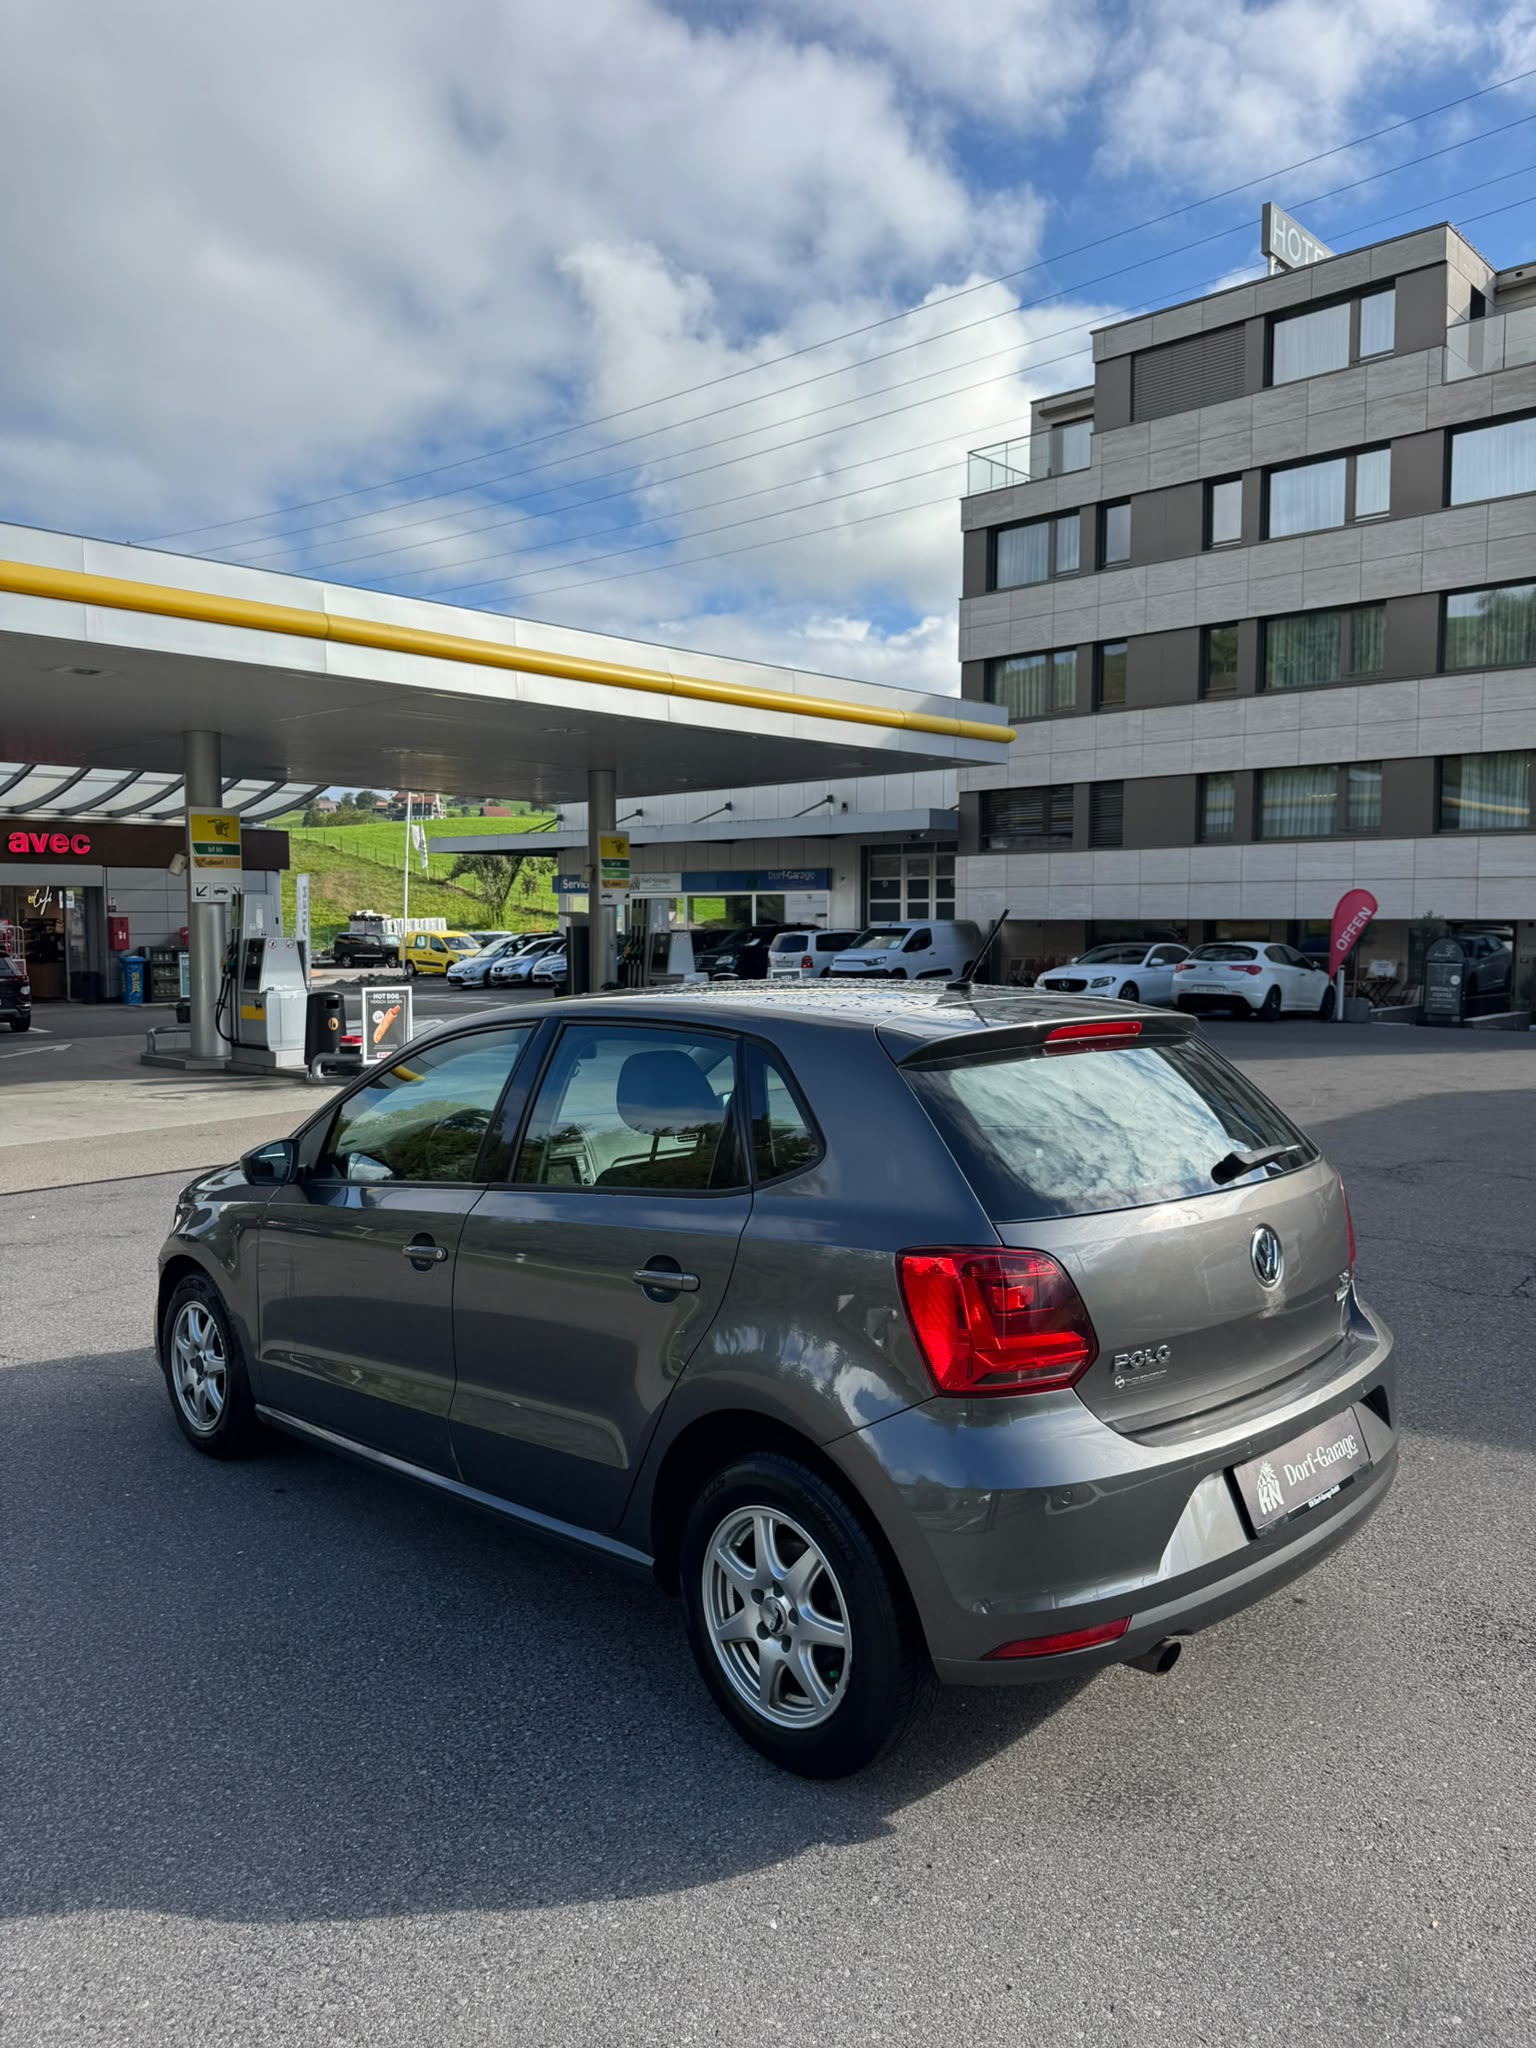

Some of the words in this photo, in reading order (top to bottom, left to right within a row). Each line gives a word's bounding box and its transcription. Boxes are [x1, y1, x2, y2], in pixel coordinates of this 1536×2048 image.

[8, 831, 91, 855] avec
[1335, 906, 1373, 951] OFFEN
[1114, 1344, 1171, 1373] POLO
[1283, 1434, 1357, 1487] Dorf-Garage
